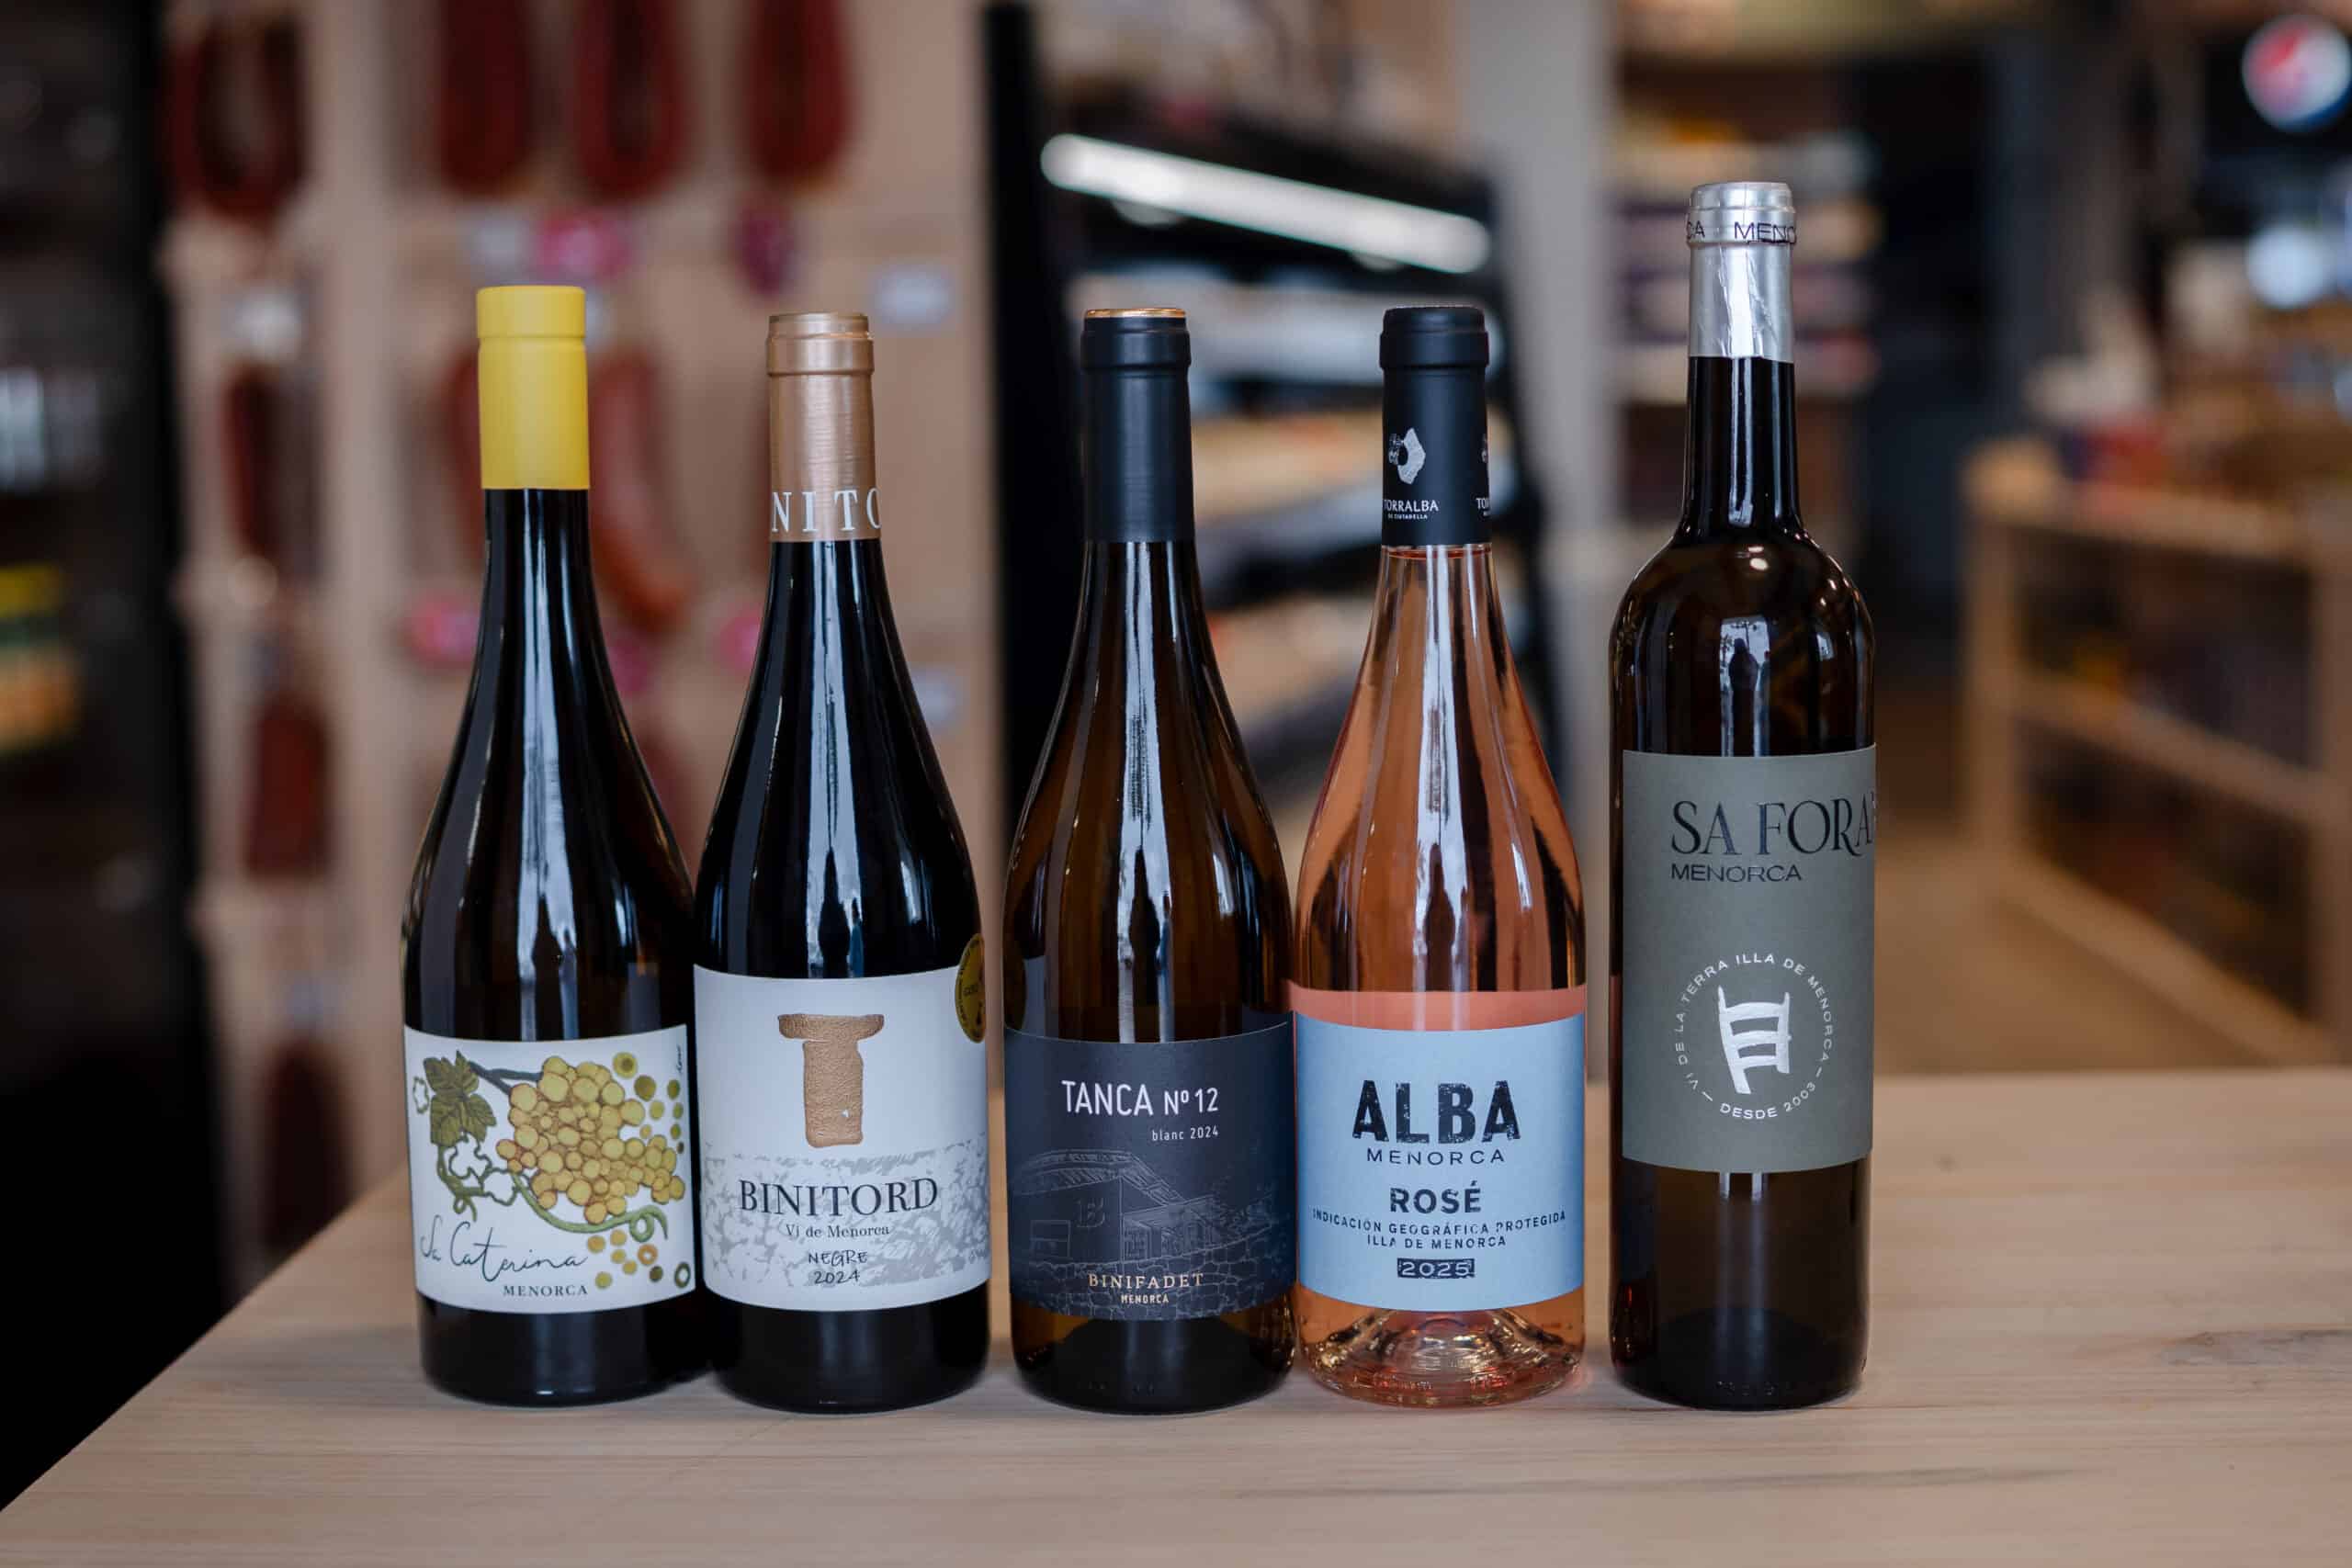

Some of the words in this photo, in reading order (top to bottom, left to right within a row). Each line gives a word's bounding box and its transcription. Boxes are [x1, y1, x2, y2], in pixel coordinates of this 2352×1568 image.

[1671, 800, 1741, 855] SA
[1671, 863, 1802, 883] MENORCA
[1736, 953, 1775, 965] ILLA
[1783, 958, 1805, 976] DE
[1680, 960, 1728, 1004] TERRA
[1674, 1012, 1686, 1033] LA
[1807, 976, 1834, 1062] MENORCA
[1675, 1042, 1689, 1066] DE
[1061, 1079, 1154, 1116] TANCA
[1719, 1102, 1778, 1120] DESDE
[1783, 1081, 1815, 1112] 2003
[1351, 1079, 1521, 1144] ALBA
[1151, 1128, 1184, 1141] blanc
[1190, 1125, 1219, 1139] 2024
[1366, 1148, 1505, 1166] MENORCA
[739, 1177, 938, 1217] BINITORD
[1389, 1179, 1482, 1214] ROSÉ
[805, 1224, 822, 1238] de
[827, 1224, 890, 1238] Menorca
[1388, 1222, 1489, 1236] GEOGRÁFICA
[1496, 1210, 1566, 1233] PROTEGIDA
[450, 1221, 588, 1282] Caterina
[1367, 1234, 1396, 1247] ILLA
[1404, 1237, 1424, 1249] DE
[1431, 1235, 1506, 1249] MENORCA
[808, 1249, 868, 1268] NEGRE
[814, 1269, 861, 1284] 2024
[1400, 1261, 1471, 1278] 2025
[1087, 1272, 1204, 1290] BINIFADET
[503, 1285, 589, 1298] MENORCA
[1120, 1292, 1170, 1304] MENORCA
